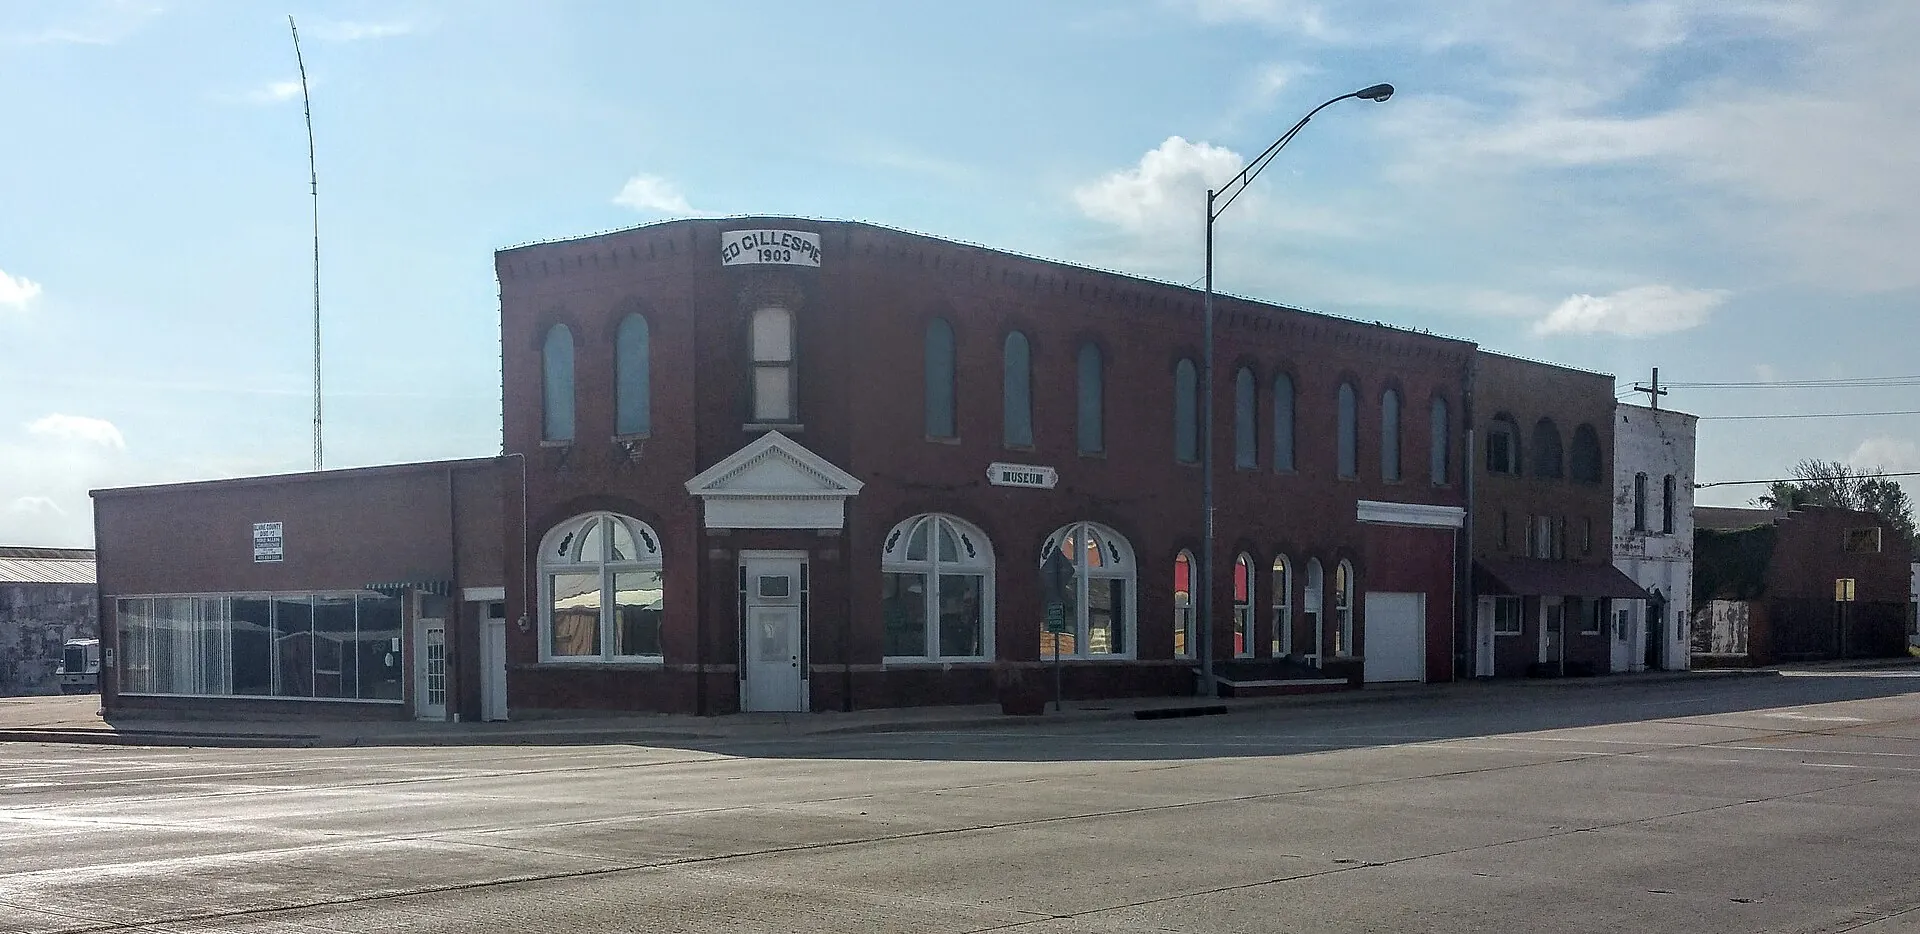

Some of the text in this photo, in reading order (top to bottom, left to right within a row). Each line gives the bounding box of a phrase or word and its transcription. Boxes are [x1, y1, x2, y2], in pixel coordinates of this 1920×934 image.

[722, 231, 820, 264] ED GILLESPIE
[757, 249, 791, 262] 1903
[1003, 471, 1043, 484] MUSEUM
